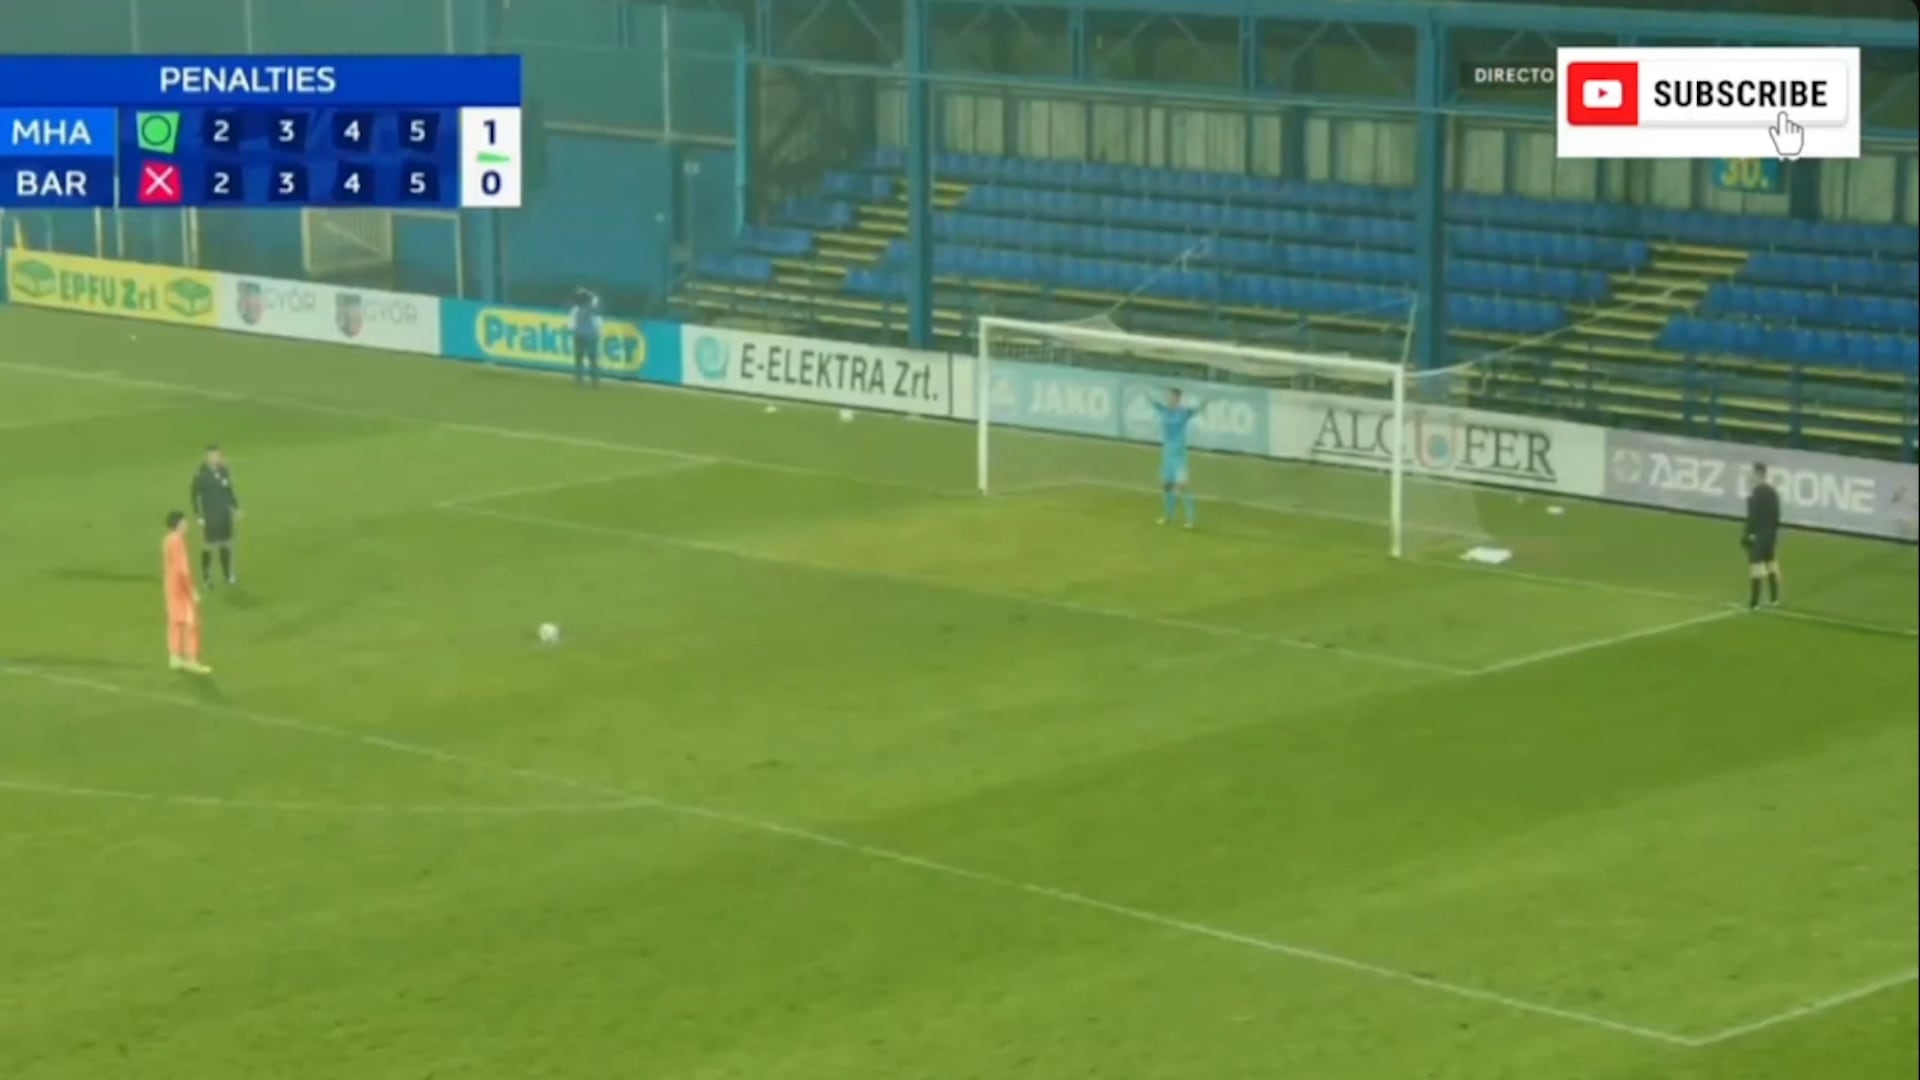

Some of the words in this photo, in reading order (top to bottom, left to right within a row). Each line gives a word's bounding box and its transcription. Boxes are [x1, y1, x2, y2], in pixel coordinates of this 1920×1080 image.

[740, 343, 886, 396] E-ELEKTRA
[893, 360, 939, 401] Zrt.
[1031, 377, 1109, 417] JAKO
